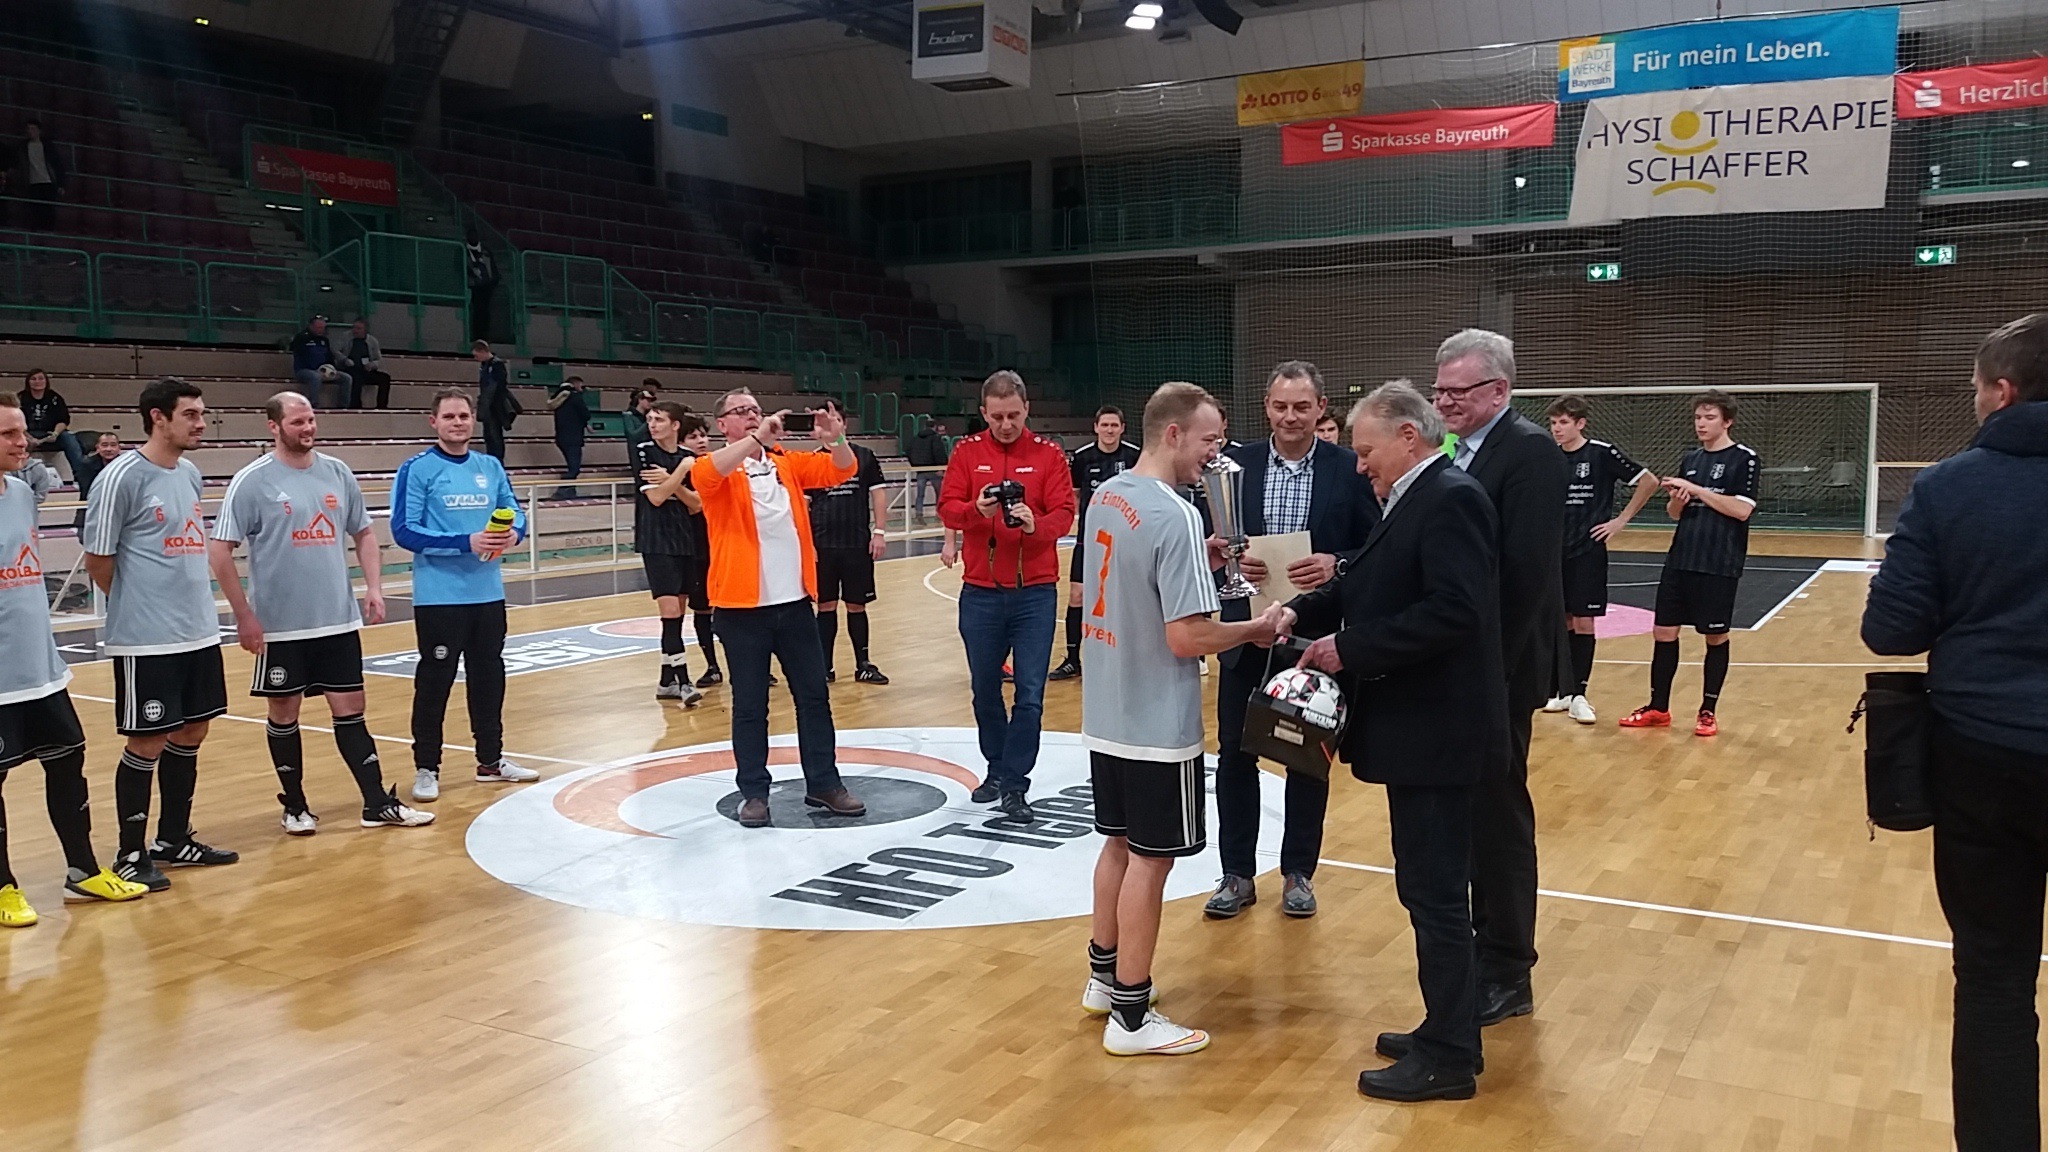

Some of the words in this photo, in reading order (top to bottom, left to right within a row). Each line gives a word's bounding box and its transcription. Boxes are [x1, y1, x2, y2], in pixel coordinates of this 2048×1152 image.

[1572, 47, 1612, 63] STADT
[1633, 51, 1671, 73] Für
[1679, 44, 1737, 68] mein
[1746, 40, 1831, 64] Leben.
[1572, 60, 1612, 76] WERKE
[1572, 76, 1612, 88] Bayreuth
[1261, 89, 1309, 107] LOTTO
[1312, 86, 1321, 101] 6
[1342, 82, 1361, 98] 49
[1351, 132, 1431, 152] Sparkasse
[1435, 124, 1510, 147] Bayreuth
[1627, 149, 1810, 185] SCHAFFER
[338, 171, 392, 191] Bayreuth
[155, 507, 165, 522] 6
[283, 501, 292, 515] 5
[292, 529, 324, 540] KOLB
[565, 537, 592, 547] BLOCK
[1092, 529, 1114, 618] 7
[769, 847, 1015, 920] HFO
